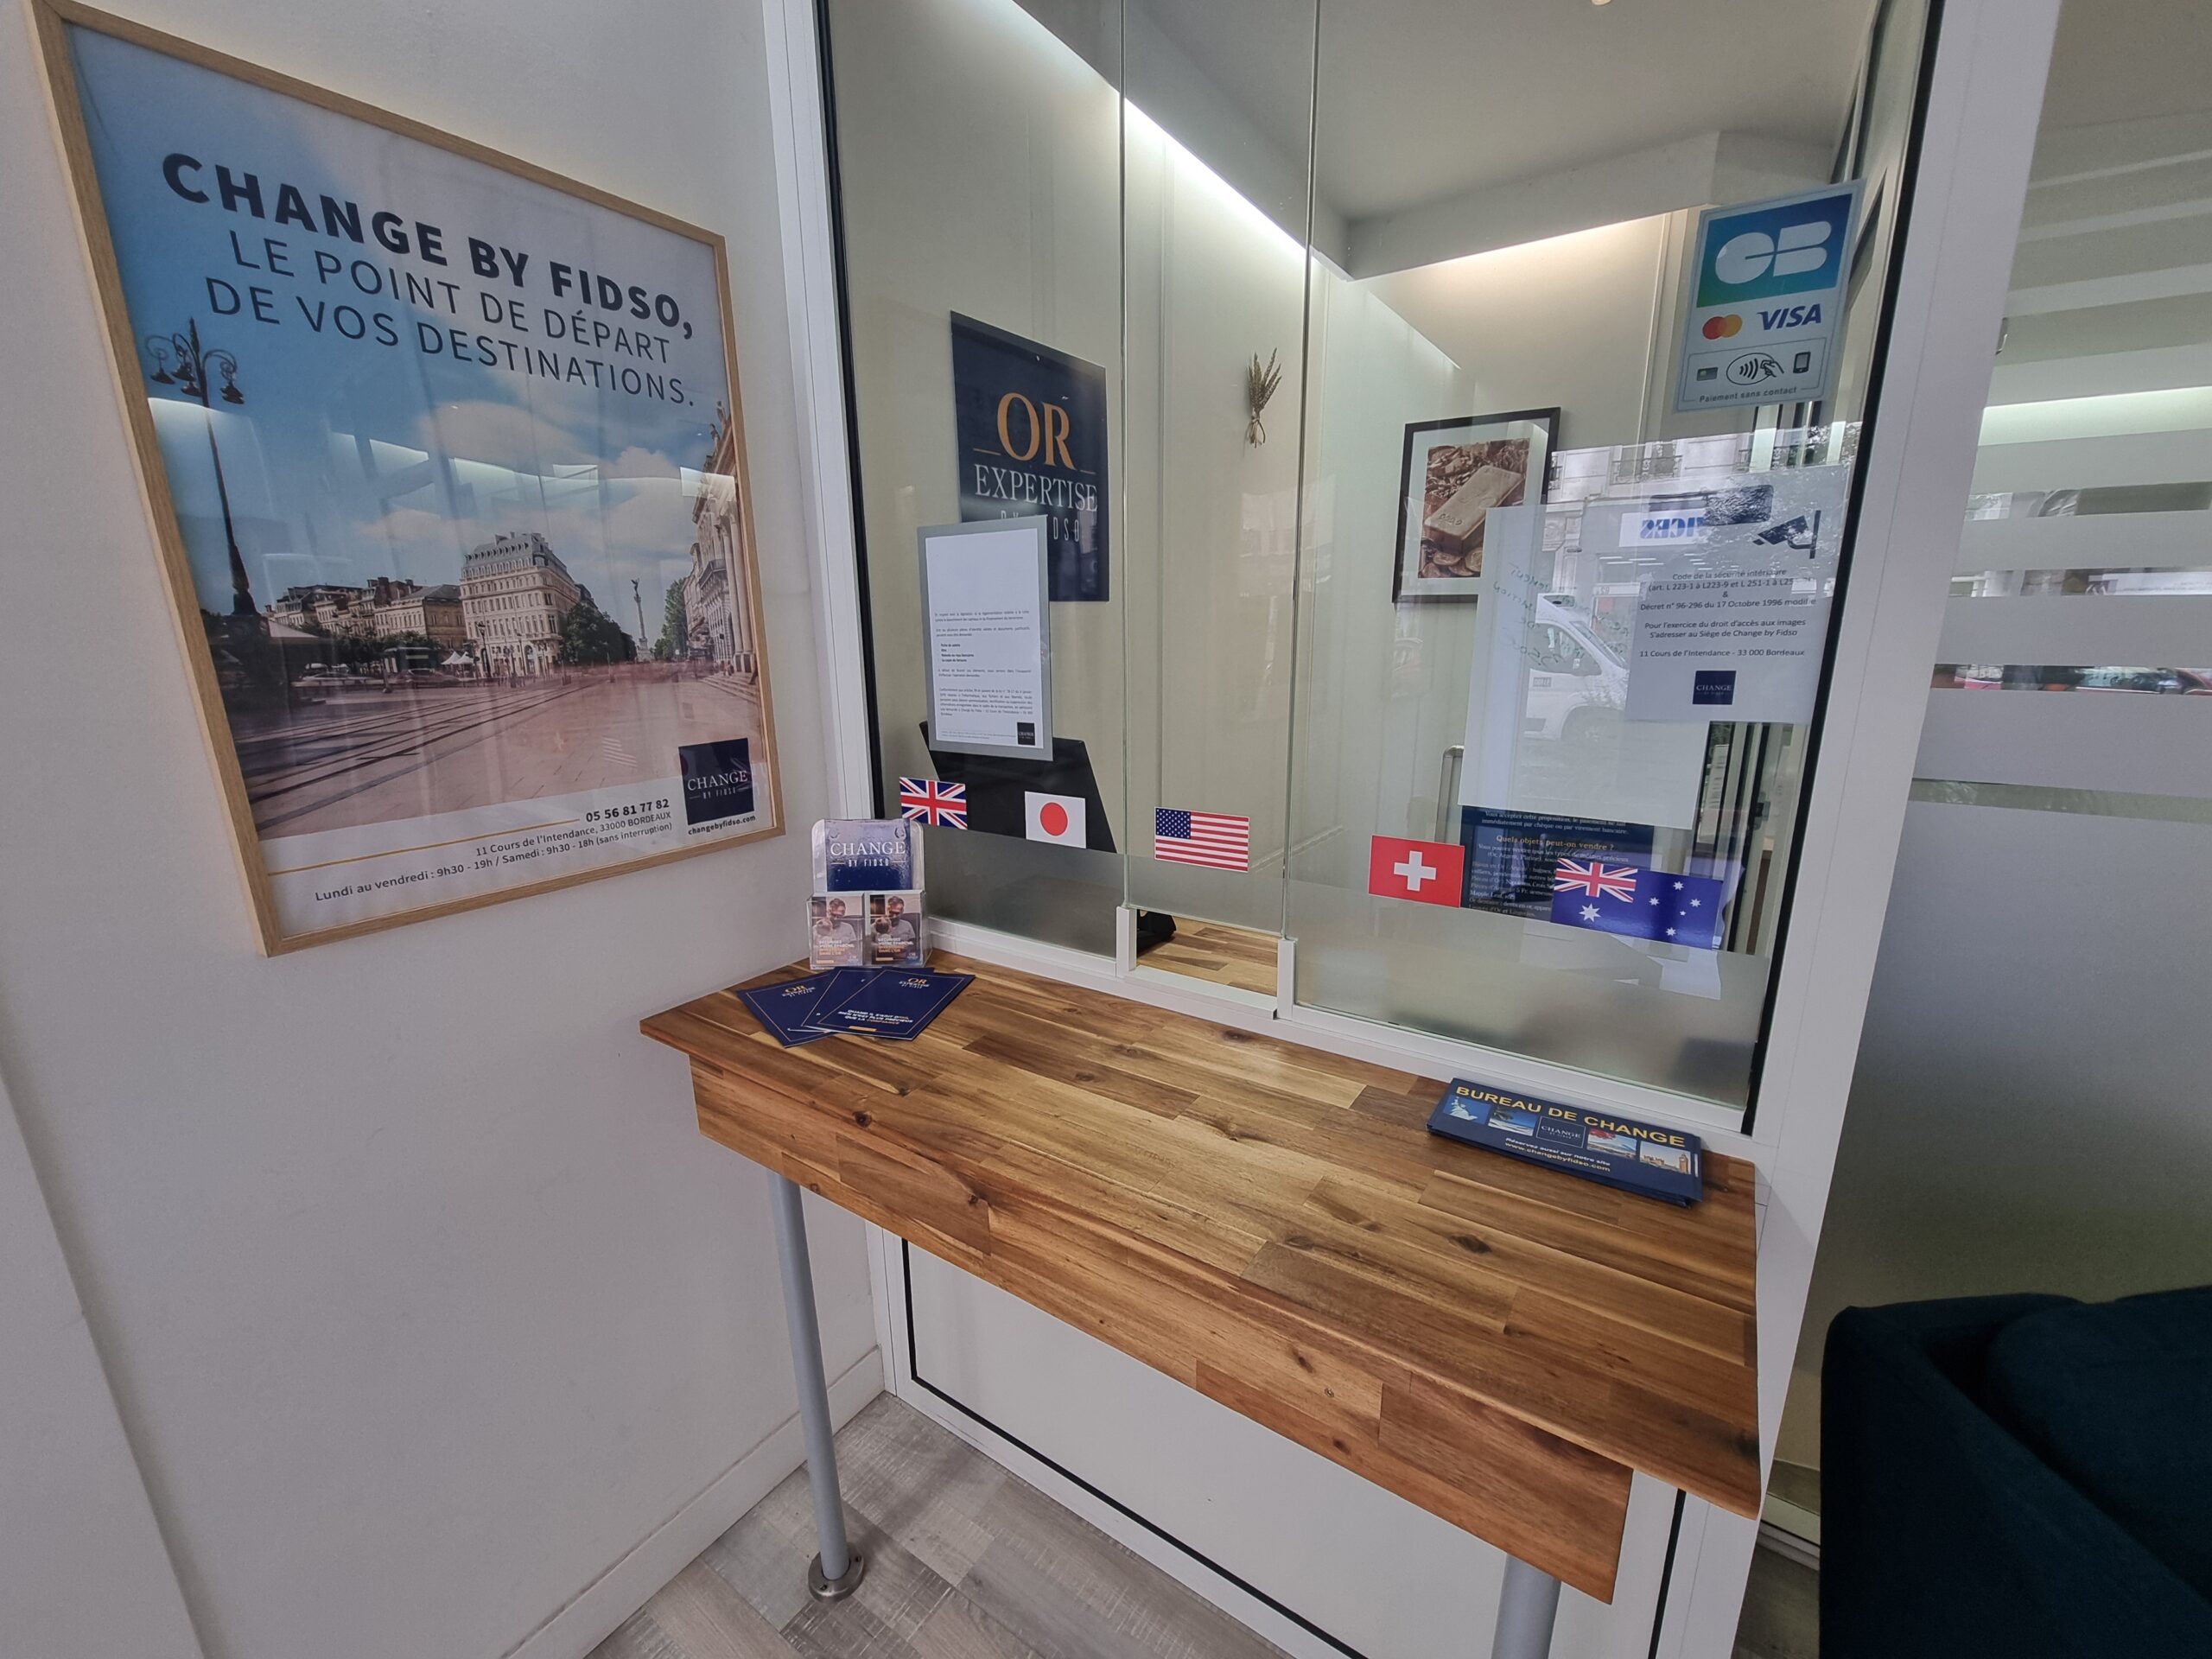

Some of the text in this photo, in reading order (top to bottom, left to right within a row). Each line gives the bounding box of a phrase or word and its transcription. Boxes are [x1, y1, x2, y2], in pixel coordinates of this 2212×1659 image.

[162, 152, 694, 340] CHANGE BY FIDSO,
[1715, 220, 1832, 284] CB
[230, 229, 671, 365] LE POINT DE DÉPART
[1757, 304, 1822, 331] VISA
[205, 276, 695, 408] DE VOS DESTINATIONS.
[1699, 386, 1797, 403] Paiement sans contact
[997, 392, 1076, 470] OR
[974, 463, 1098, 512] EXPERTISE
[1649, 583, 1664, 592] (art.
[688, 770, 748, 791] CHANGE
[585, 802, 654, 823] 05 56 81 77
[688, 814, 756, 836] changebyfidso.com
[1534, 822, 1554, 830] chèque
[476, 811, 671, 857] 11 Cours de l'Intendance, 33000 BORDEAUX
[1496, 834, 1518, 843] Quels
[1519, 836, 1543, 846] objets
[1546, 839, 1577, 849] peut-on
[1580, 842, 1607, 850] vendre
[315, 886, 353, 901] Lundi
[357, 883, 372, 894] au
[374, 870, 429, 890] vendredi
[436, 864, 464, 878] 9h30
[474, 858, 493, 871] 19h
[501, 848, 540, 865] Samedi
[546, 842, 570, 855] 9h30
[578, 836, 594, 849] 18h
[595, 834, 620, 848] (sans
[621, 822, 672, 842] interruption)
[830, 841, 906, 856] CHANGE
[849, 859, 858, 868] BY
[1456, 1086, 1686, 1147] BUREAU DE CHANGE
[1541, 1125, 1581, 1139] CHANGE
[1504, 1141, 1611, 1173] www.changebyfidso.com
[1505, 1137, 1538, 1149] Réservez
[1540, 1144, 1559, 1154] aussi
[1574, 1154, 1595, 1162] notre
[1596, 1158, 1611, 1166] site
